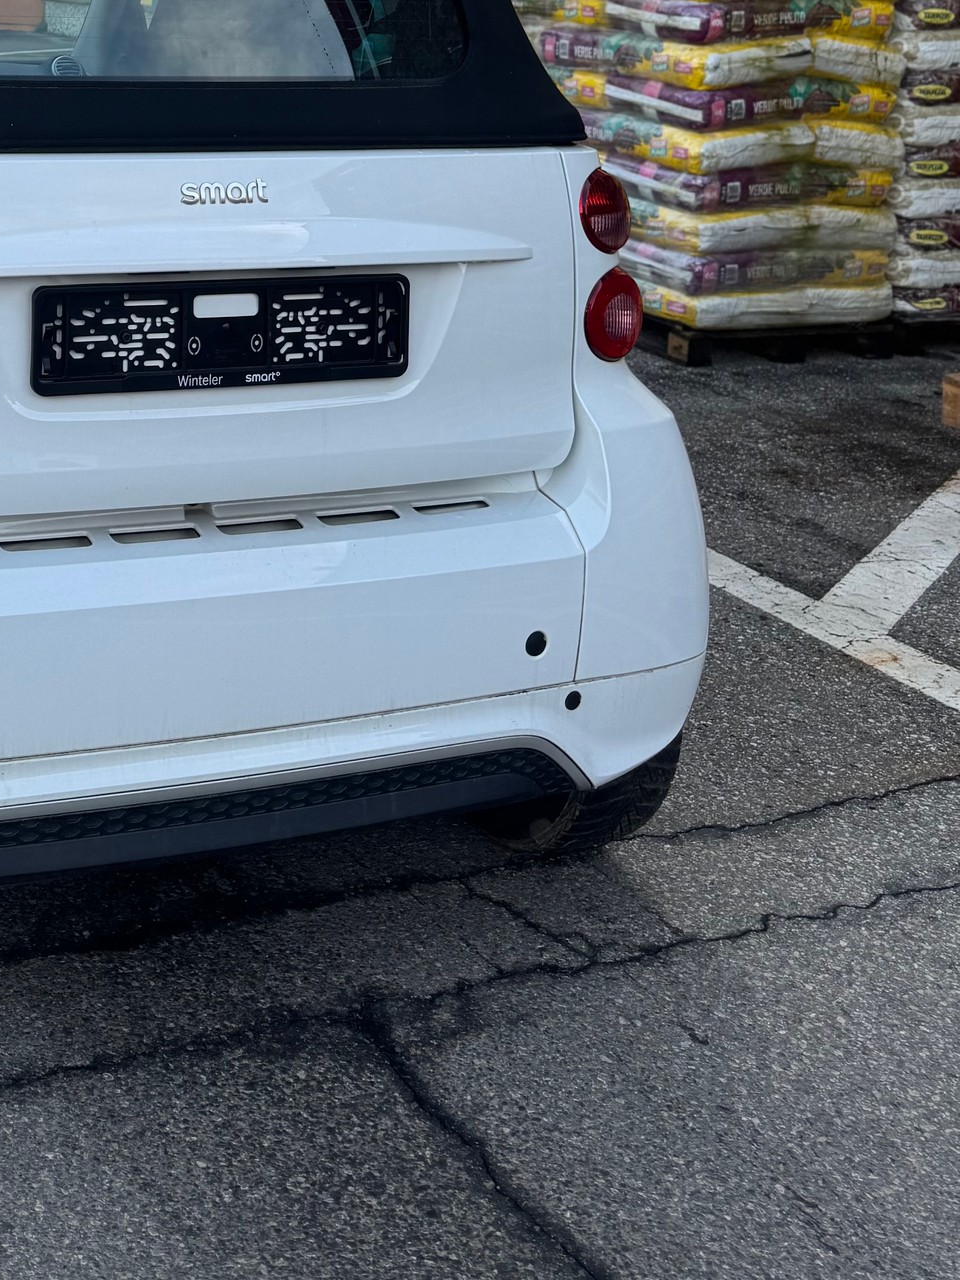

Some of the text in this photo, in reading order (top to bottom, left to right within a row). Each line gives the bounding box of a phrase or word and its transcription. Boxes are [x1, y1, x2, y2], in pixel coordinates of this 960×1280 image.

[574, 45, 593, 58] VERDE
[753, 99, 778, 114] VERDE
[181, 178, 268, 205] smart
[748, 183, 774, 196] VERDE
[178, 374, 223, 387] Winteler
